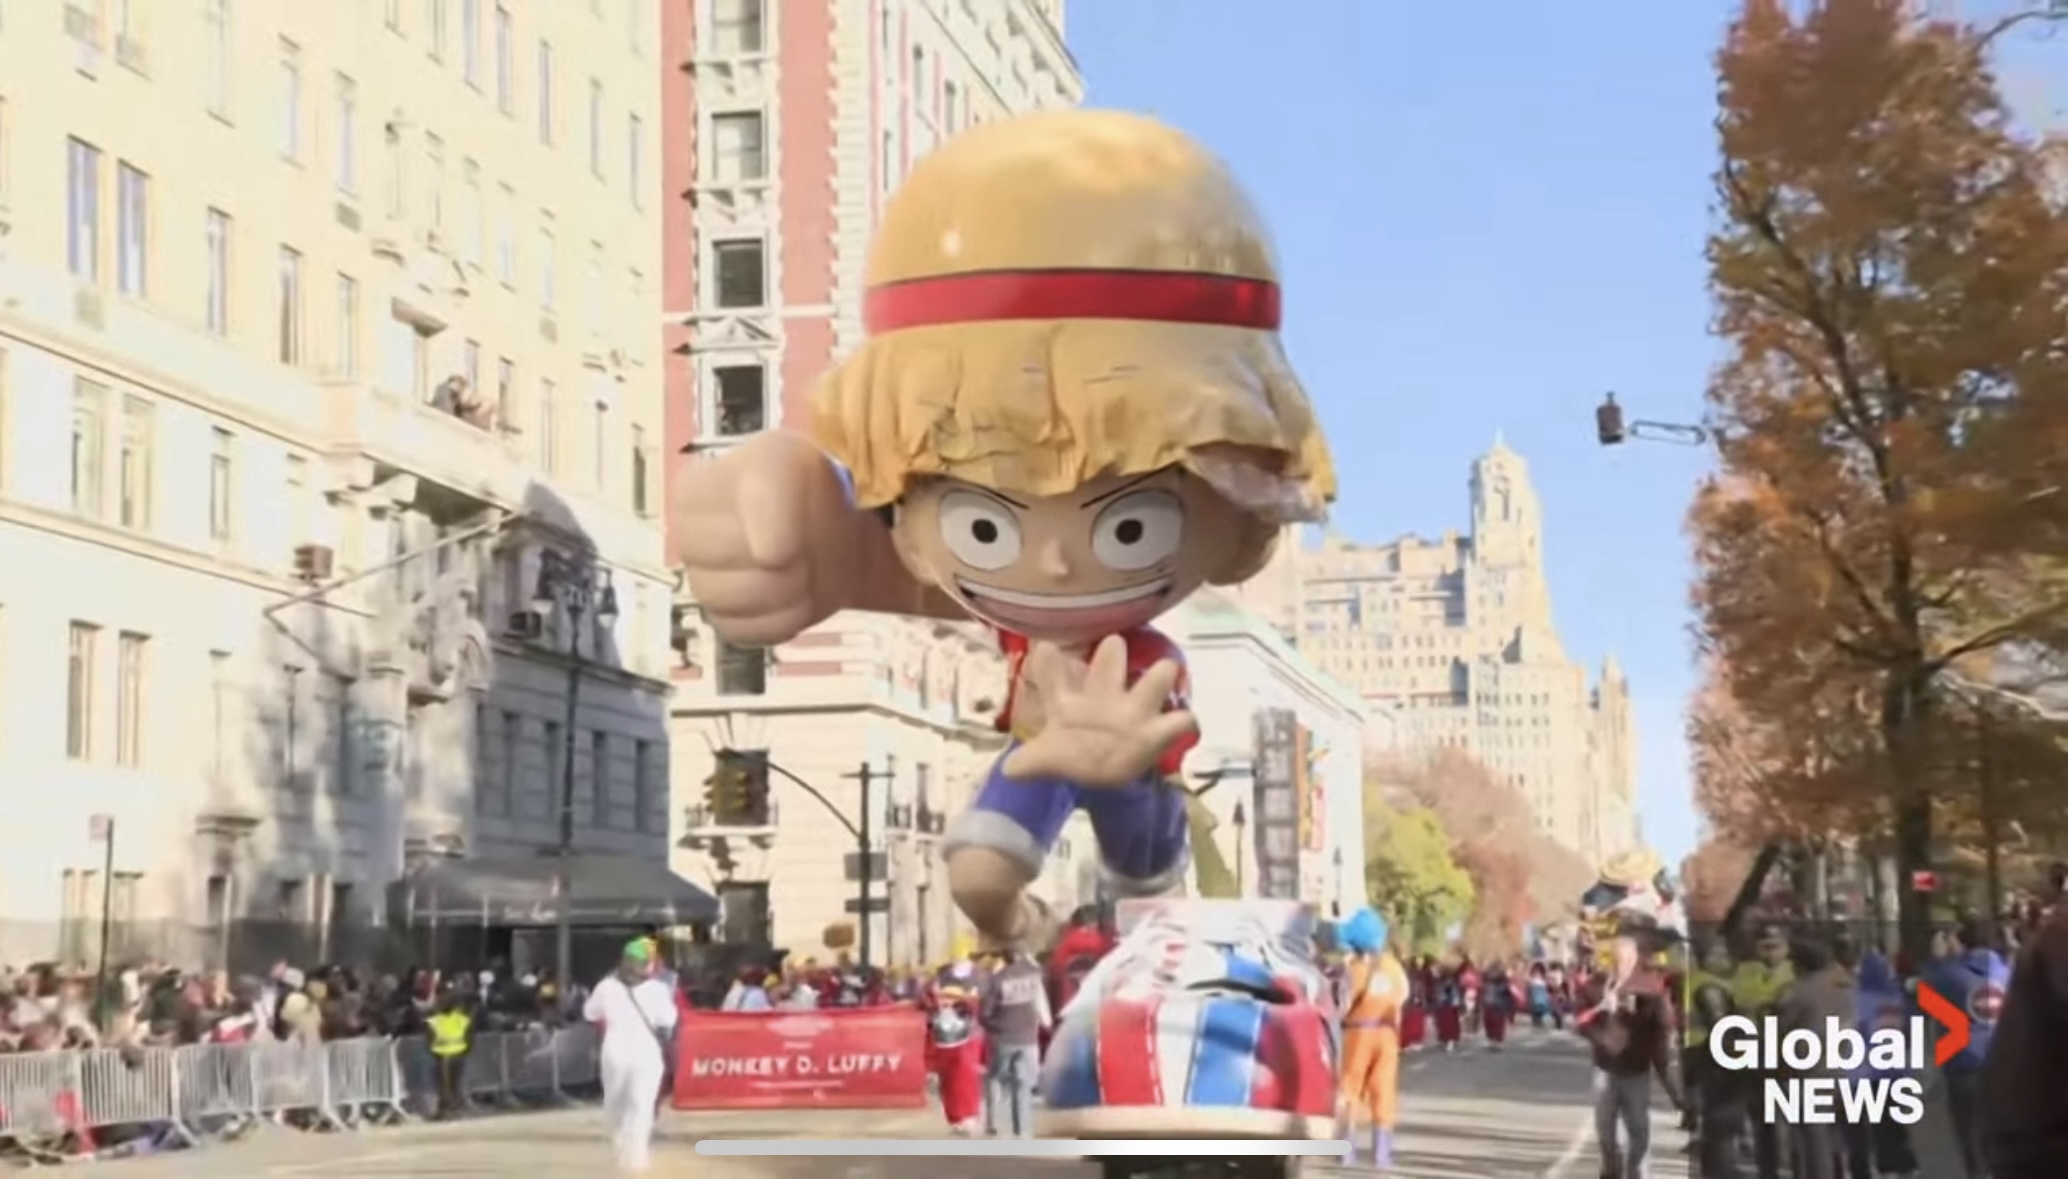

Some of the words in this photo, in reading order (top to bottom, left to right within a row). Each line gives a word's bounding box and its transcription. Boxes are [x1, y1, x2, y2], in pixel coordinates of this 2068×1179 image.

[691, 1056, 788, 1076] MONKEY
[796, 1056, 820, 1073] D.
[828, 1055, 902, 1074] LUFFY
